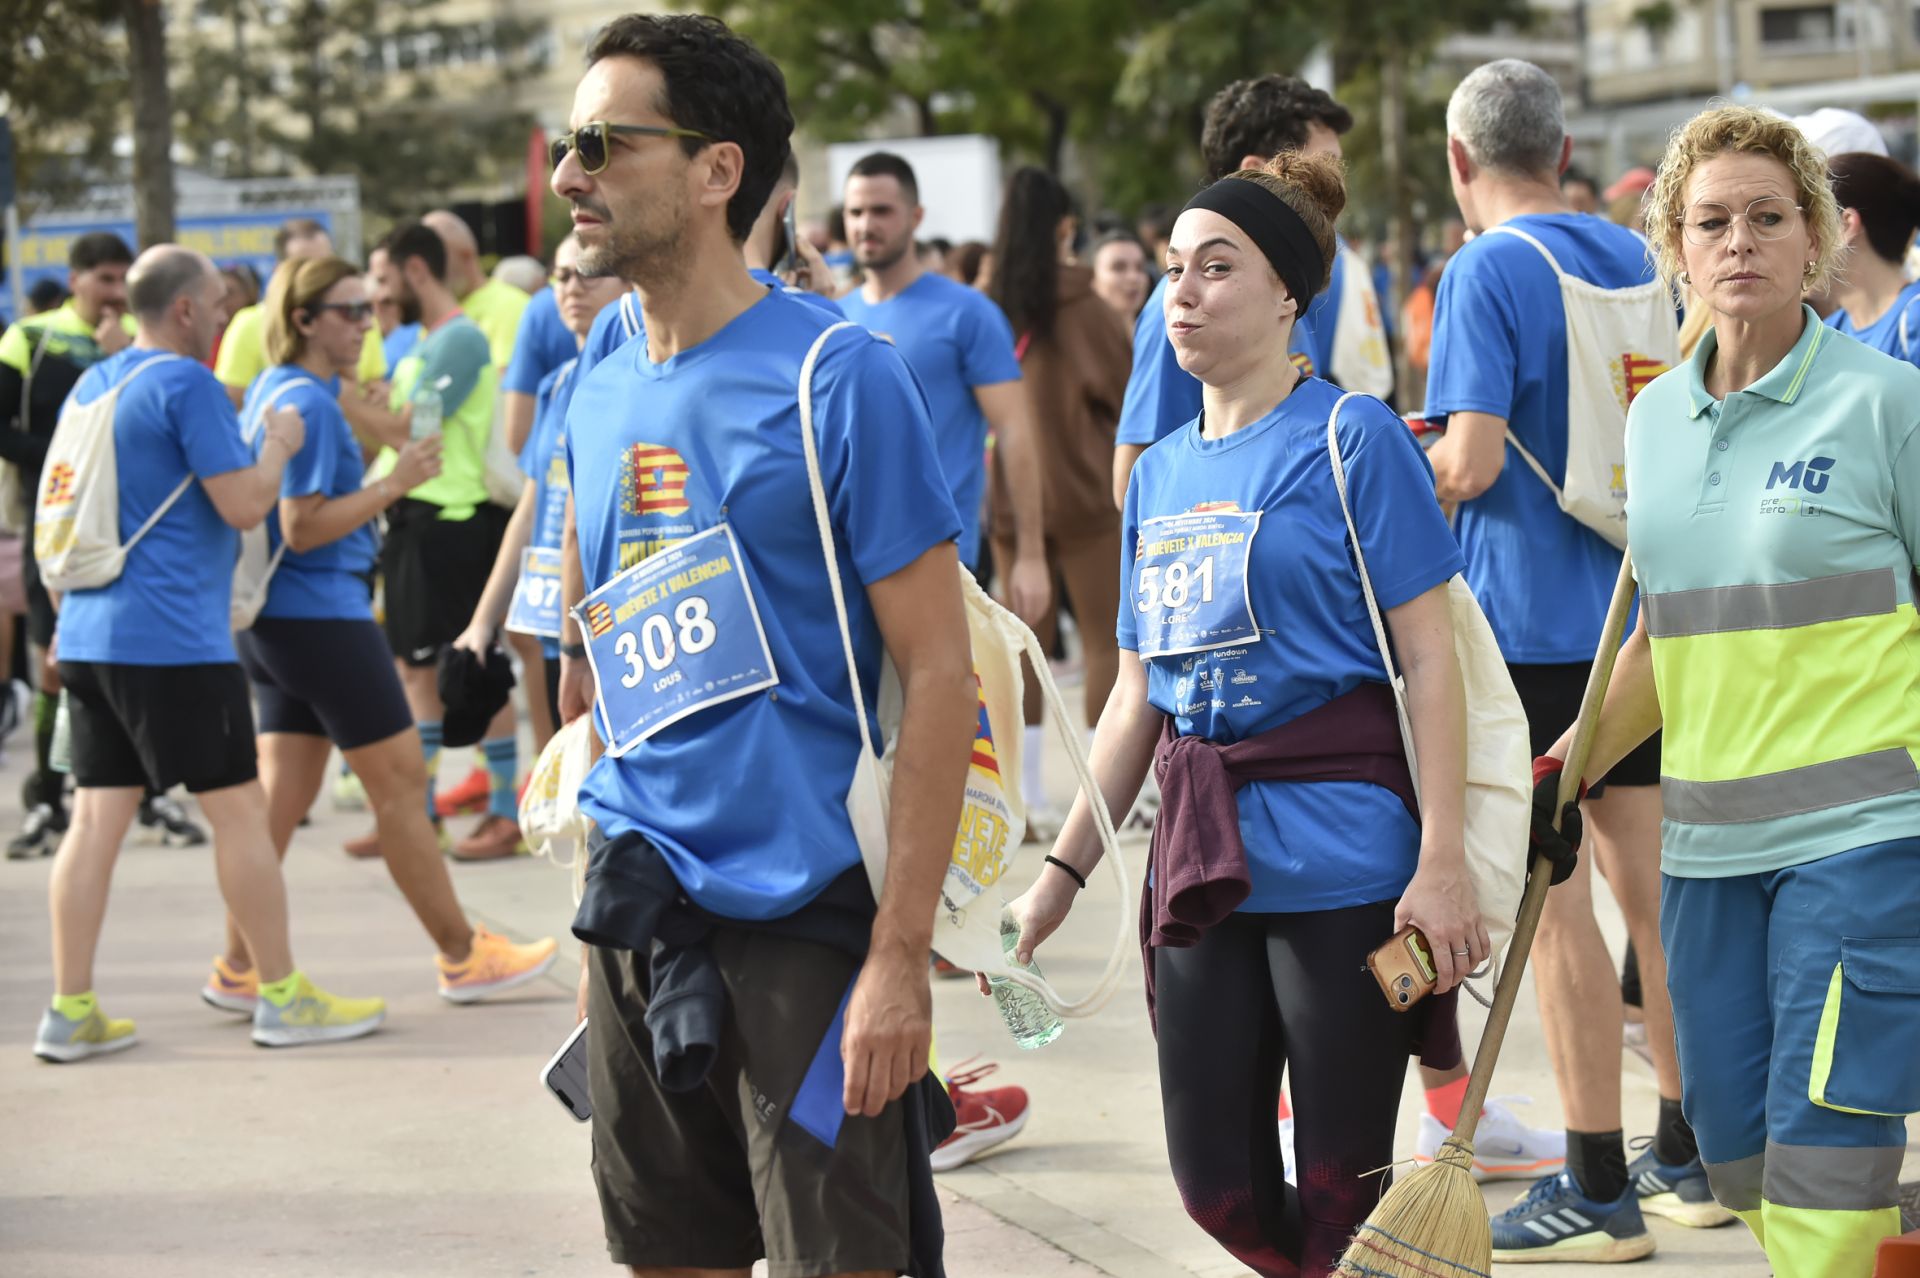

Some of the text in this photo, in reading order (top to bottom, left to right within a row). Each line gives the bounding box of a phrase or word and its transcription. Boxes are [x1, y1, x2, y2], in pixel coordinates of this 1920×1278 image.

[1760, 506, 1786, 514] zero
[1761, 498, 1779, 507] pre
[1195, 532, 1245, 549] VALENCIA
[658, 579, 669, 599] X
[668, 555, 732, 593] VALENCIA
[1137, 555, 1214, 613] 581
[614, 595, 717, 689] 308
[652, 670, 682, 693] LOUS
[966, 787, 996, 806] MARCHA
[959, 803, 1010, 860] VETE
[751, 1085, 777, 1117] ORE
